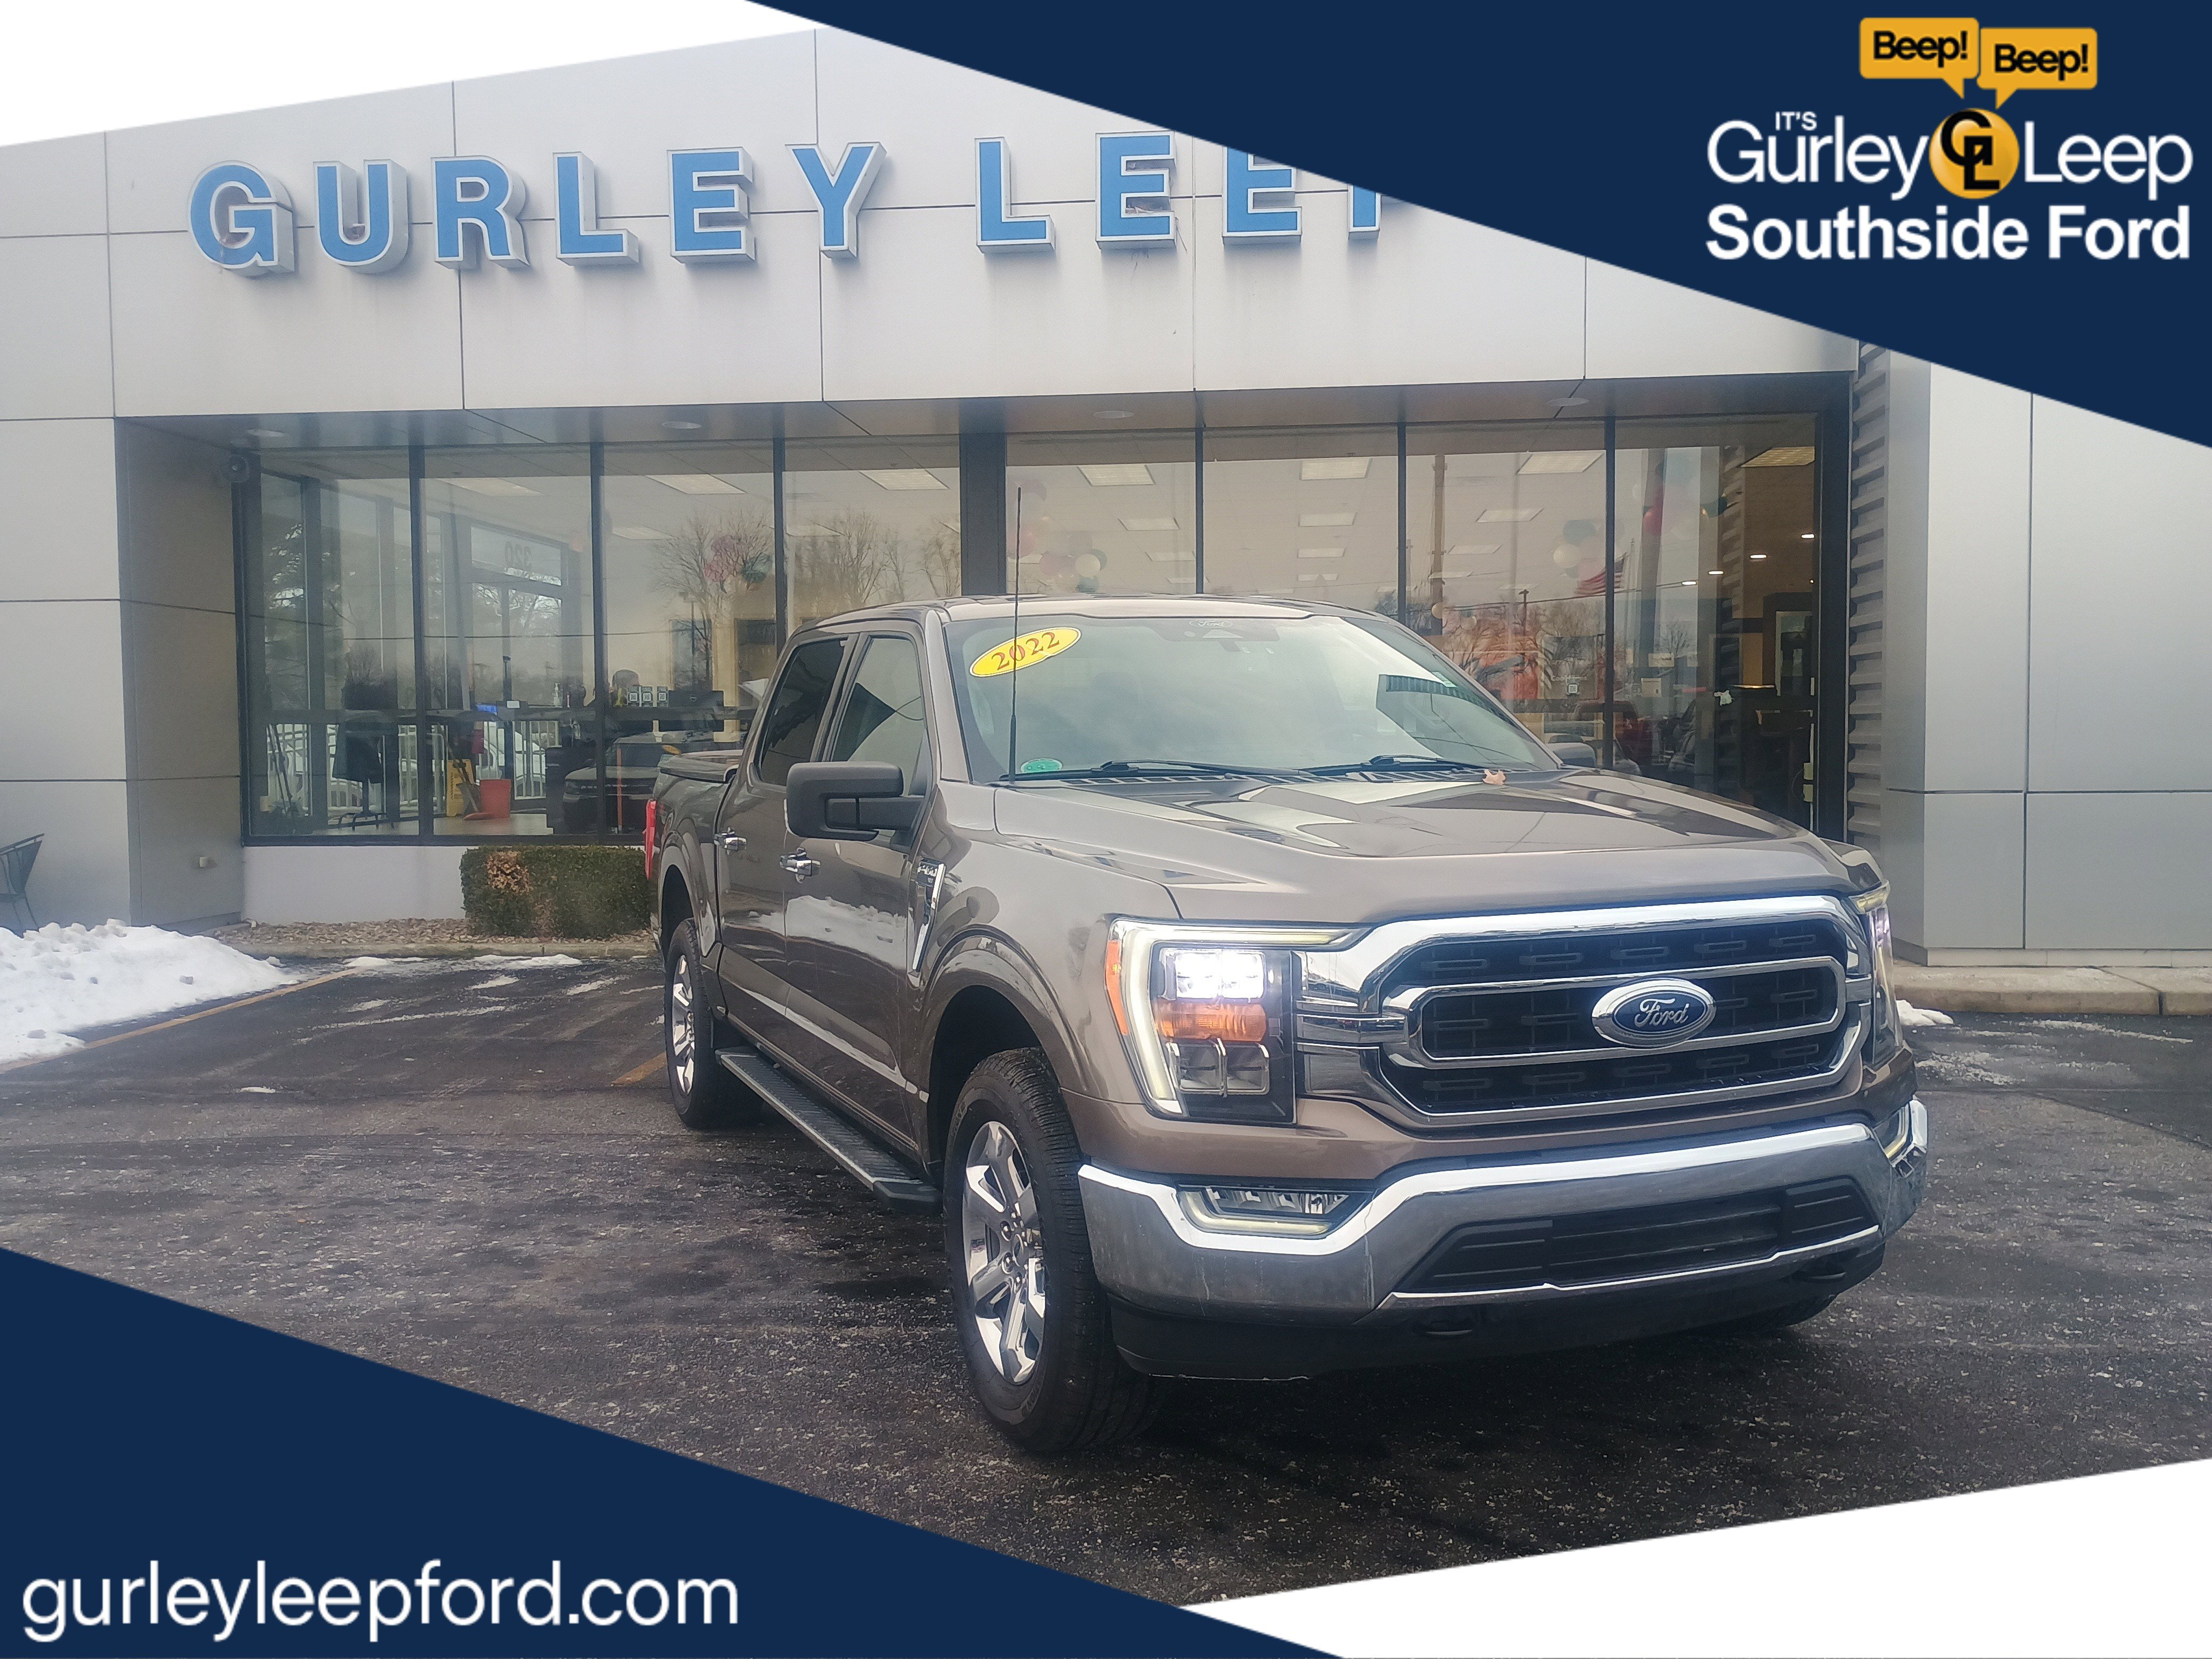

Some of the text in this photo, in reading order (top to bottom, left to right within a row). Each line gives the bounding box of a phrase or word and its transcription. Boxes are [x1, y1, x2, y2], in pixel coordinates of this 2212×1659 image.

[188, 141, 886, 276] GURLEY
[991, 632, 1060, 671] 2022
[1634, 998, 1690, 1028] Ford
